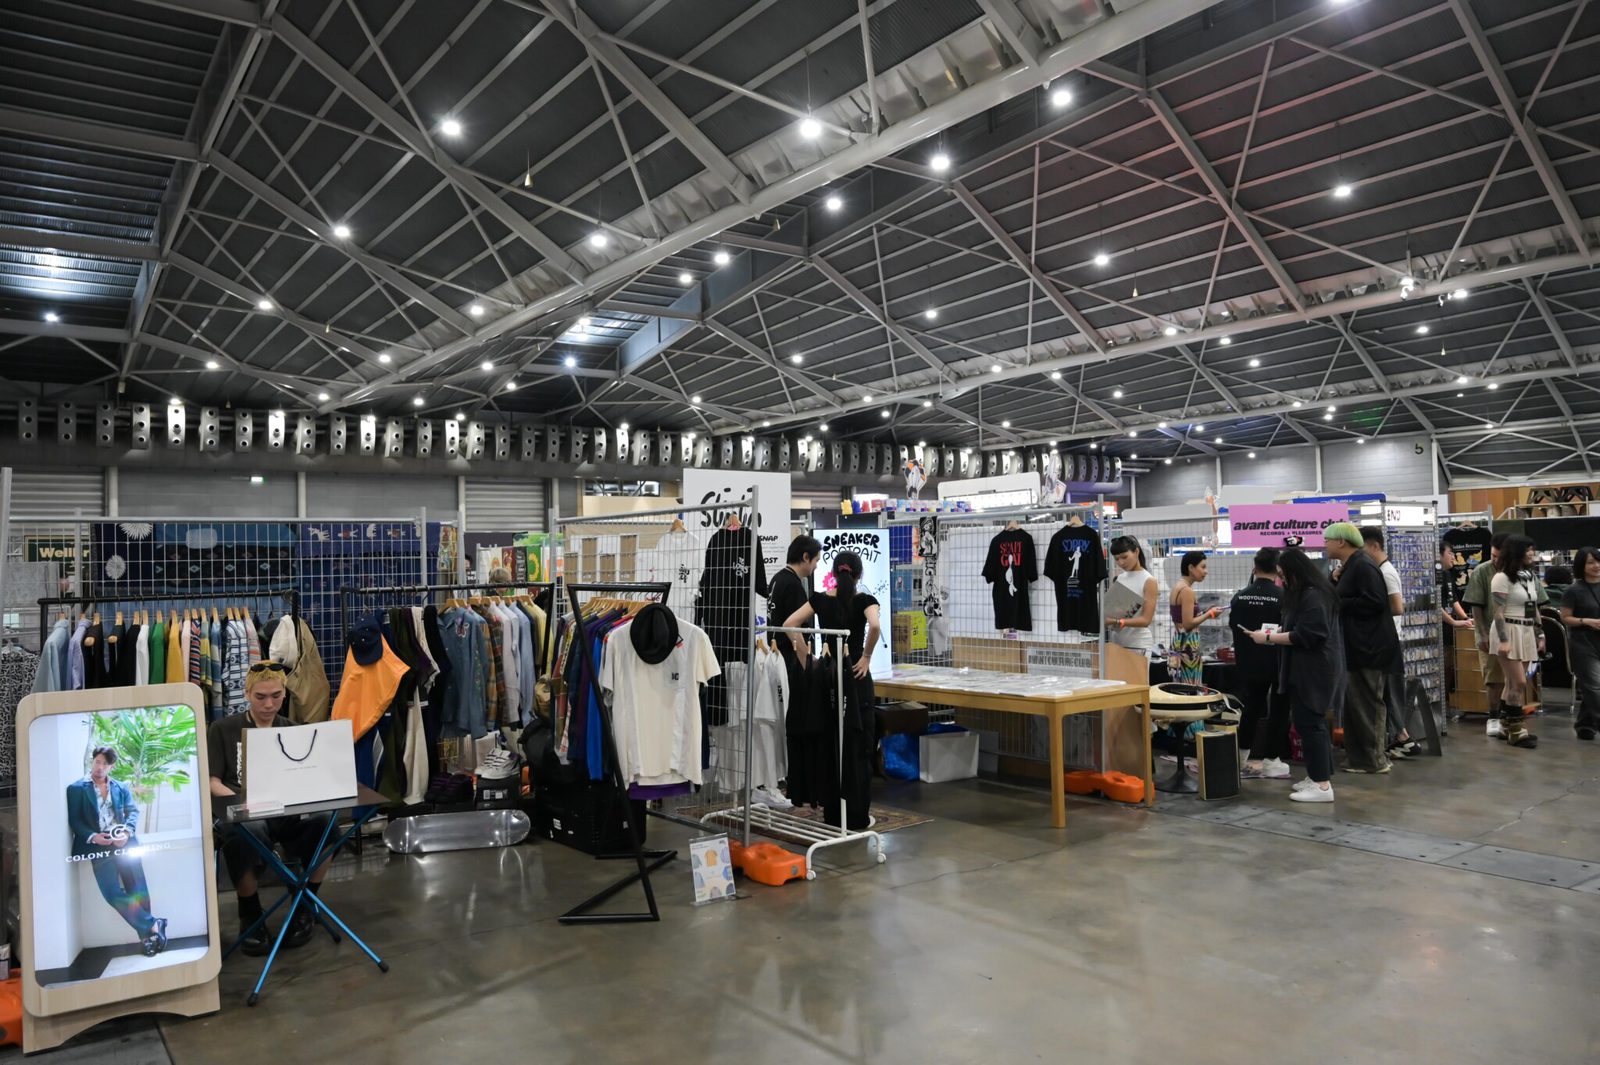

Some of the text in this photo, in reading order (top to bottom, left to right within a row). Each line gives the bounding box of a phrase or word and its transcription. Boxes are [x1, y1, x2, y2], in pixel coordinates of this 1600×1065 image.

[1234, 520, 1271, 531] avant
[1273, 519, 1318, 531] culture
[823, 532, 880, 551] SNEAKER
[39, 548, 90, 558] Wellr
[65, 850, 111, 863] COLONY
